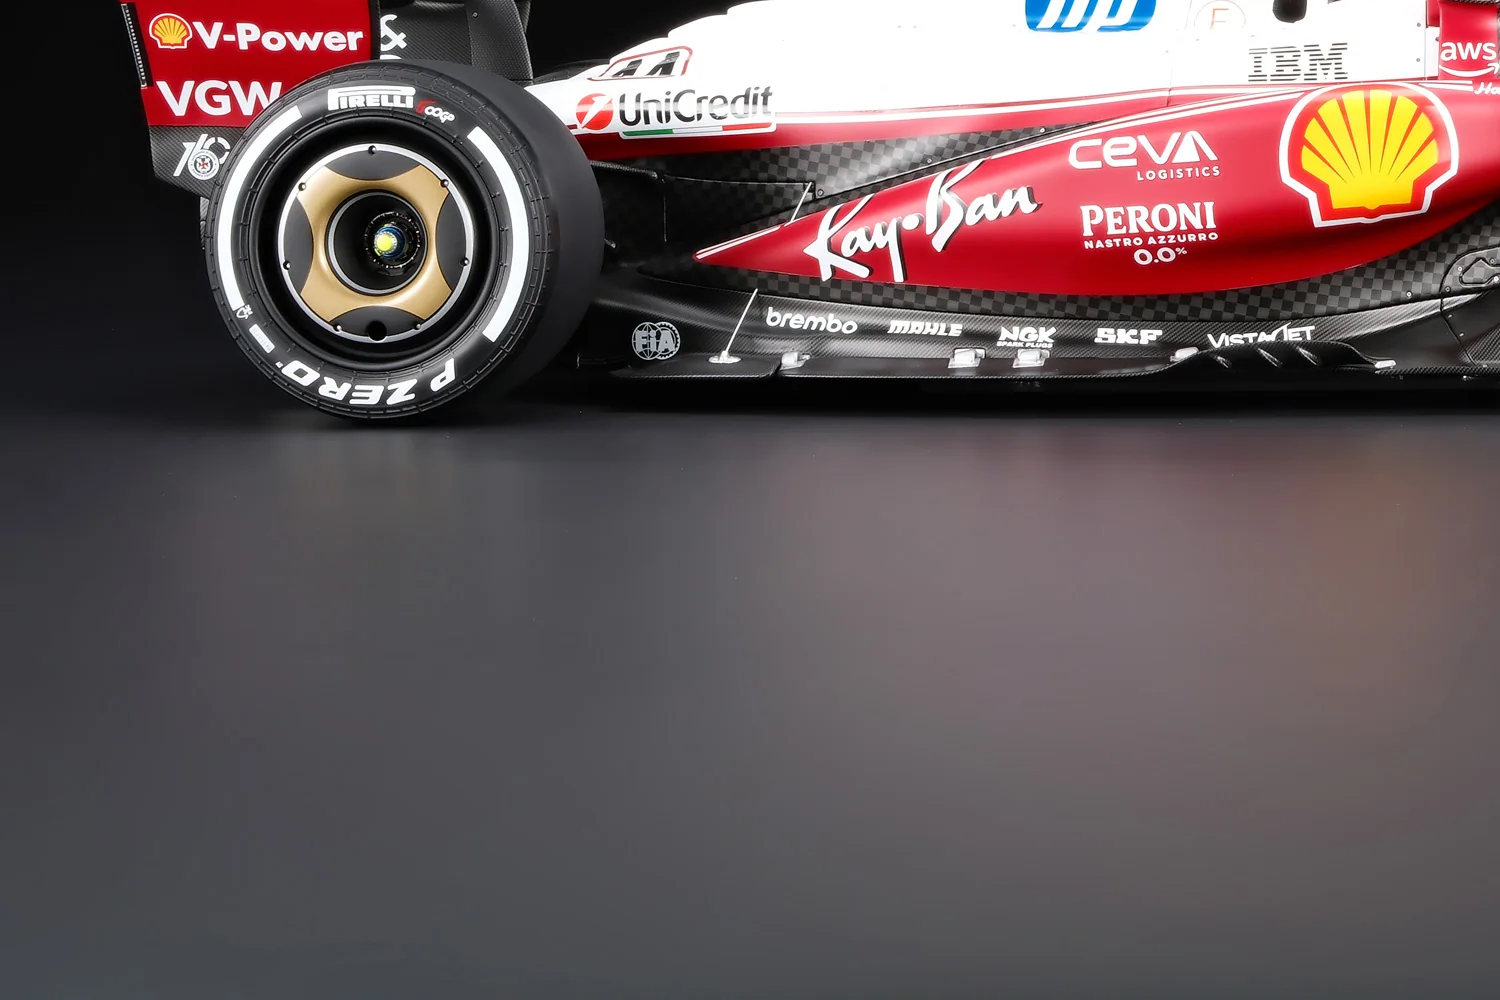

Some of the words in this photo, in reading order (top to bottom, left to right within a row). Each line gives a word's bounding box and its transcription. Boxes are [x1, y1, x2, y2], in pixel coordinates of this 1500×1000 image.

[192, 21, 364, 51] V-Power
[1248, 43, 1348, 82] IBM
[1440, 41, 1497, 62] aws
[156, 80, 282, 117] VGW
[328, 85, 416, 111] PIRELLI
[619, 86, 773, 127] UniCredit
[1137, 166, 1220, 181] LOGISTICS
[1080, 201, 1217, 237] PERONI
[1084, 237, 1143, 249] NASTRO
[1147, 232, 1219, 245] AZZURRO
[1133, 247, 1187, 265] 0.0%
[765, 307, 859, 335] brembo
[887, 320, 963, 337] MAHLE
[999, 326, 1057, 343] NGK
[1025, 341, 1053, 349] PLUGS
[1094, 327, 1163, 345] SKF
[280, 359, 418, 406] ZERO
[430, 357, 457, 392] P
